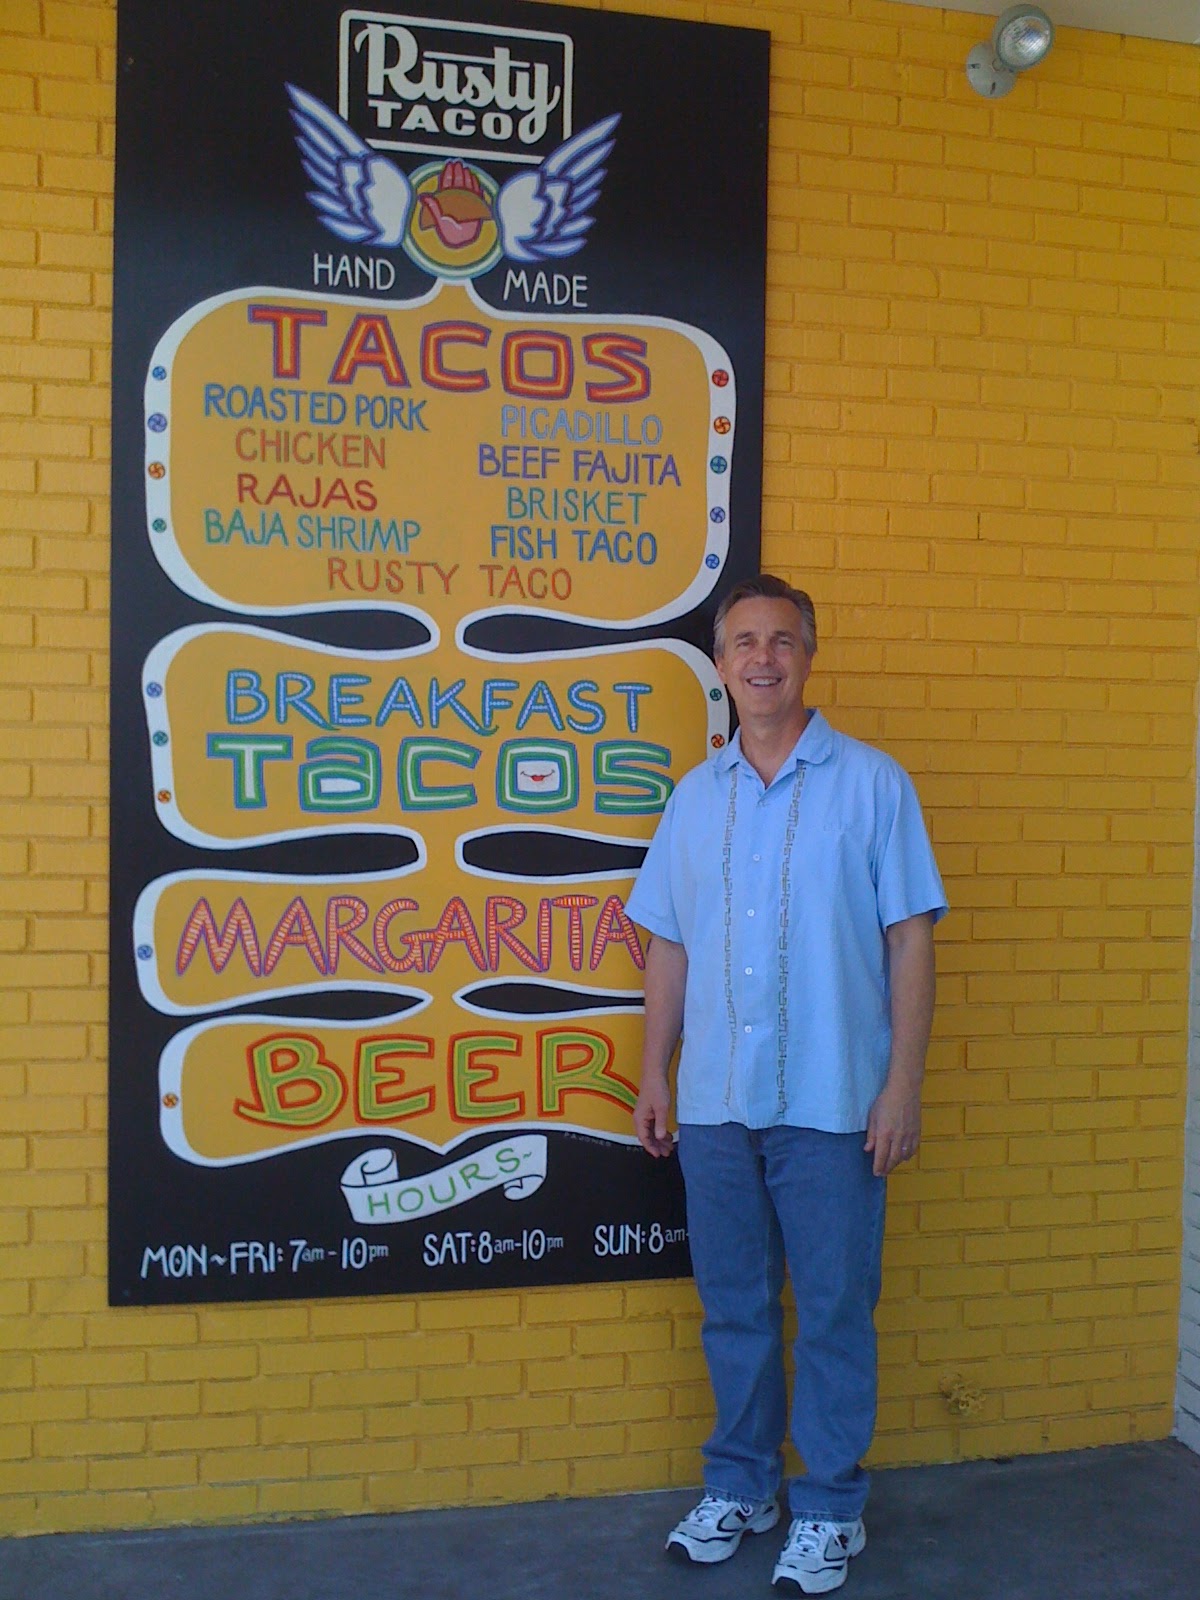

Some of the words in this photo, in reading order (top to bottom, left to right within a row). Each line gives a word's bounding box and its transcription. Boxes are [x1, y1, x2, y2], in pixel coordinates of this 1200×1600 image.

[354, 23, 560, 144] Rusty
[368, 100, 513, 140] TACO
[312, 251, 396, 291] HAND
[503, 270, 588, 308] MADE
[248, 304, 651, 404] TACOS
[204, 383, 347, 425] ROASTED
[355, 394, 429, 432] PORK
[501, 405, 663, 446] PICADILLO
[235, 427, 386, 469] CHICKEN
[478, 443, 560, 479] BEEF
[572, 450, 682, 487] FAJITA
[237, 473, 378, 511] RAJAS
[507, 487, 647, 525] BRISKET
[204, 508, 289, 547] BAJA
[297, 514, 421, 554] SHRIMP
[490, 525, 557, 561] FISH
[572, 530, 657, 566] TACO
[327, 556, 459, 595] RUSTY
[479, 565, 572, 600] TACO
[225, 669, 652, 735] BREAKFAST
[175, 894, 651, 977] MARGARITA
[233, 1026, 639, 1130] BEER
